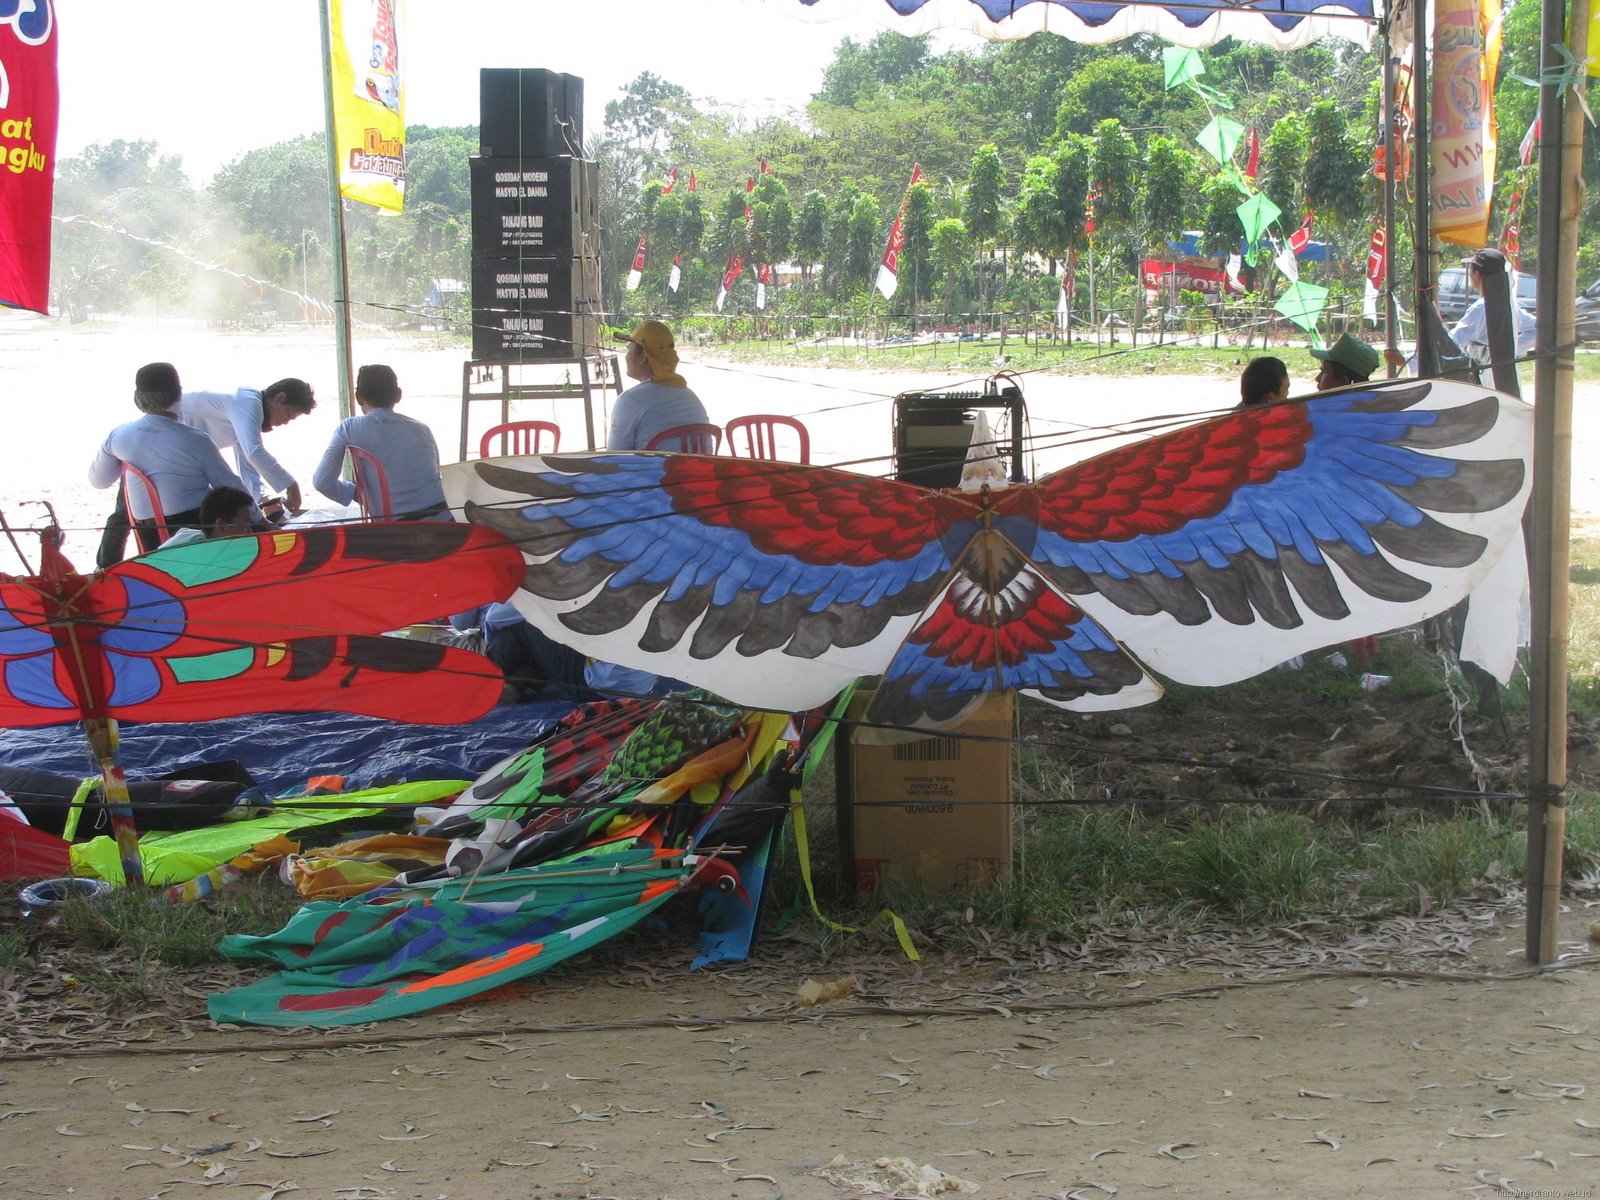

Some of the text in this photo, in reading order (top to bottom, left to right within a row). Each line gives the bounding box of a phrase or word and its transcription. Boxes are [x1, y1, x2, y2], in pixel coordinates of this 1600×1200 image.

[0, 116, 32, 141] at
[522, 172, 548, 182] MODERN
[523, 273, 549, 284] MODERN
